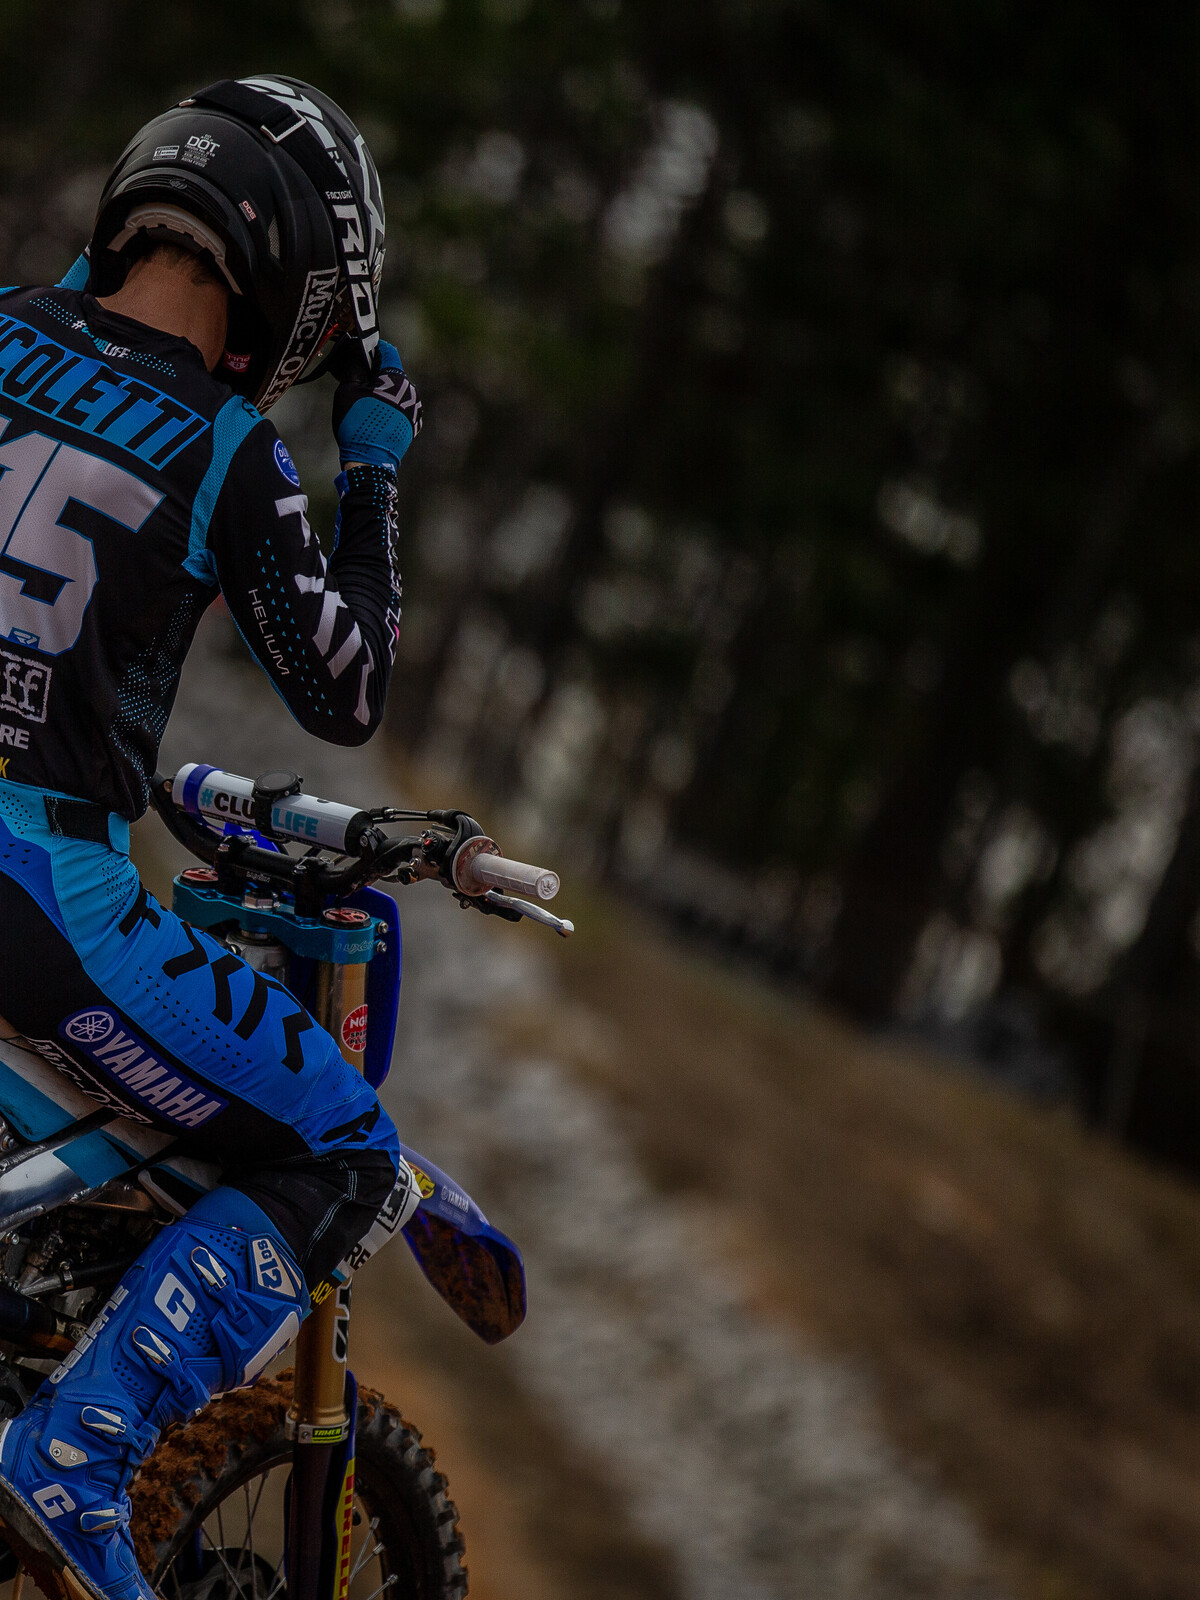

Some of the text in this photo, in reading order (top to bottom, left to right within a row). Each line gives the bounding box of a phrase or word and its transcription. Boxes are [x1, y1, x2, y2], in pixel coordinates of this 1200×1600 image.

[187, 135, 221, 153] DOT
[248, 588, 291, 676] HELIUM
[92, 1030, 222, 1127] YAMAHA
